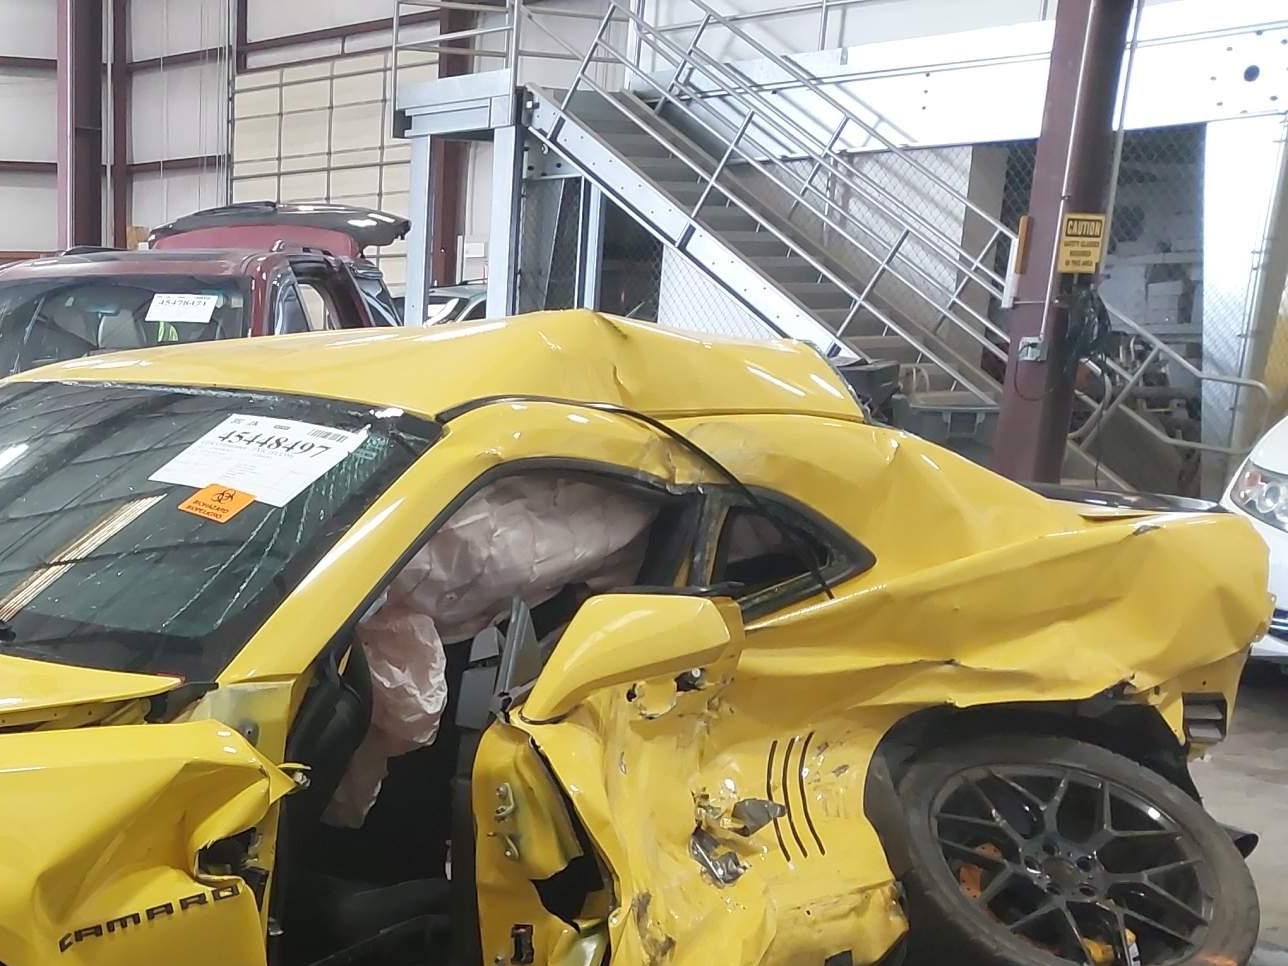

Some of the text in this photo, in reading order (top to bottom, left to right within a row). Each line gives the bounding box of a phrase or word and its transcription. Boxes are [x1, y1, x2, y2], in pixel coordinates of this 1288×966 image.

[1066, 220, 1101, 236] CAUTION
[218, 430, 331, 458] 45448497
[58, 885, 240, 953] CAMARO
